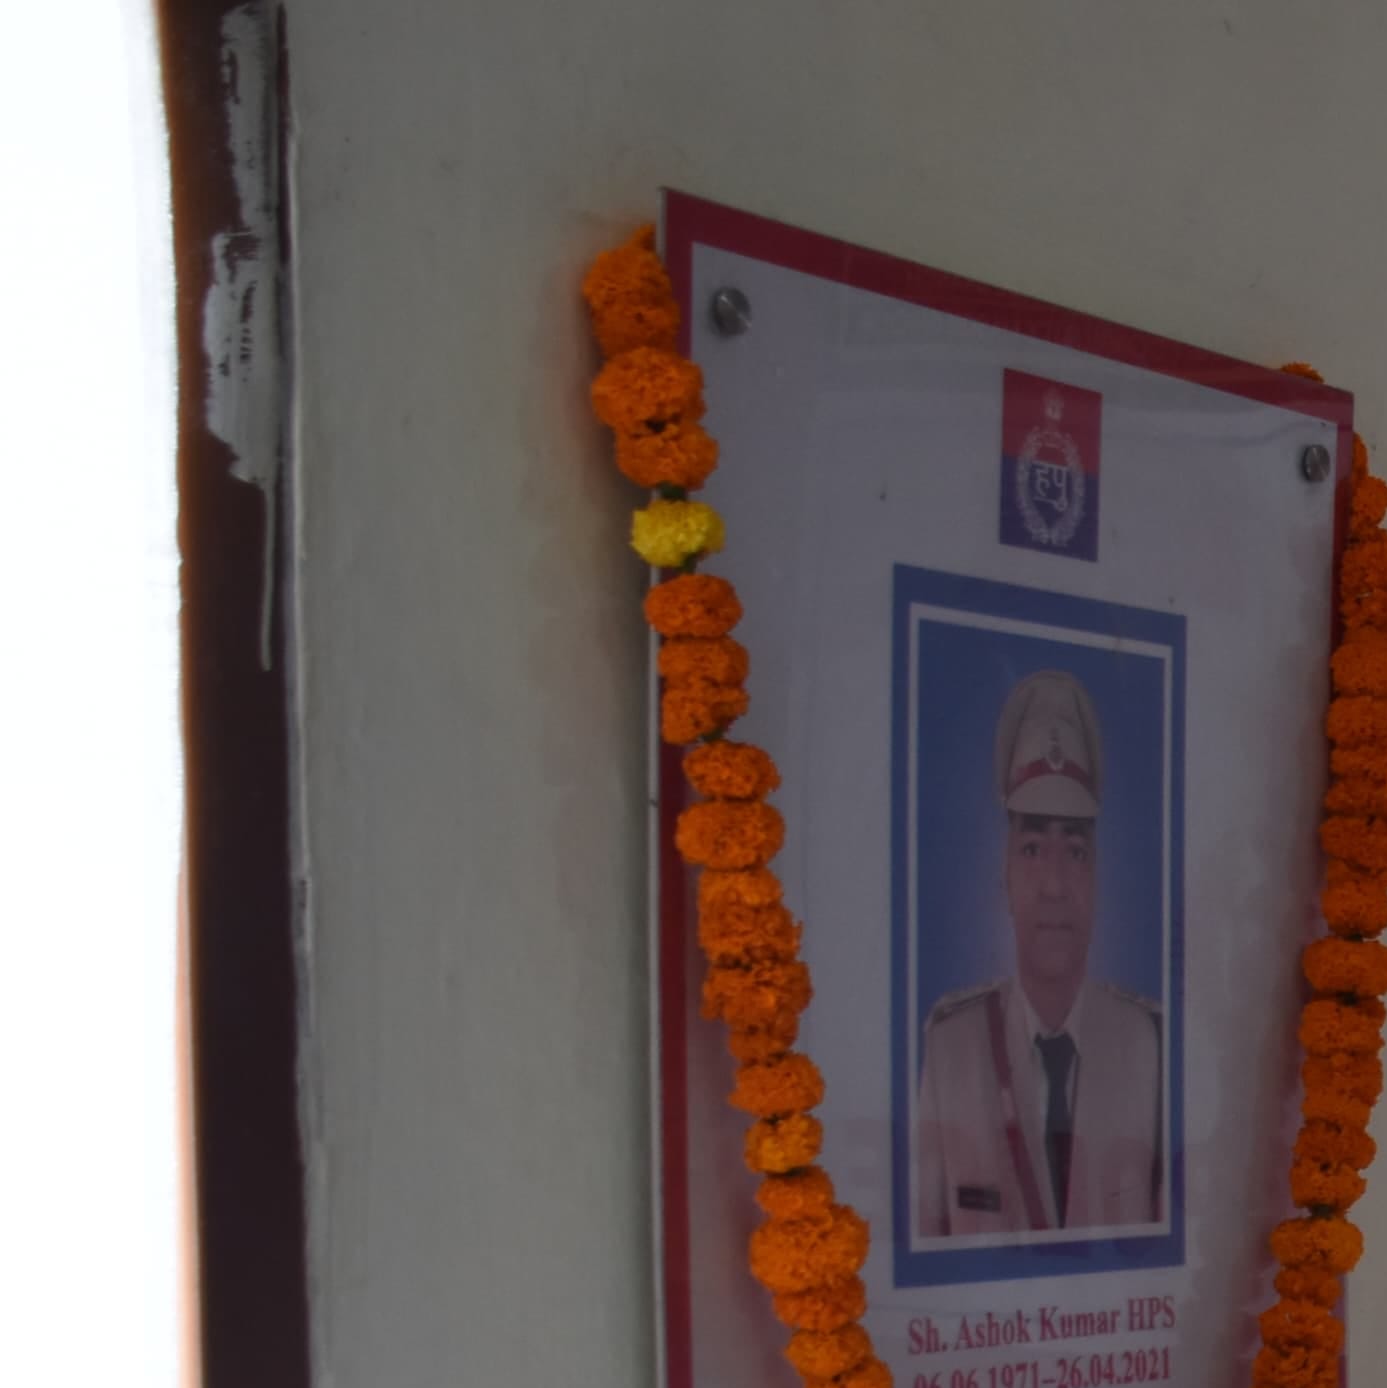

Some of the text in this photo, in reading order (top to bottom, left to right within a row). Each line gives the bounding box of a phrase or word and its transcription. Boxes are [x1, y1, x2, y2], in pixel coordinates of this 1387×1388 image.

[907, 1295, 1177, 1356] Sh. Ashok Kumar HPS
